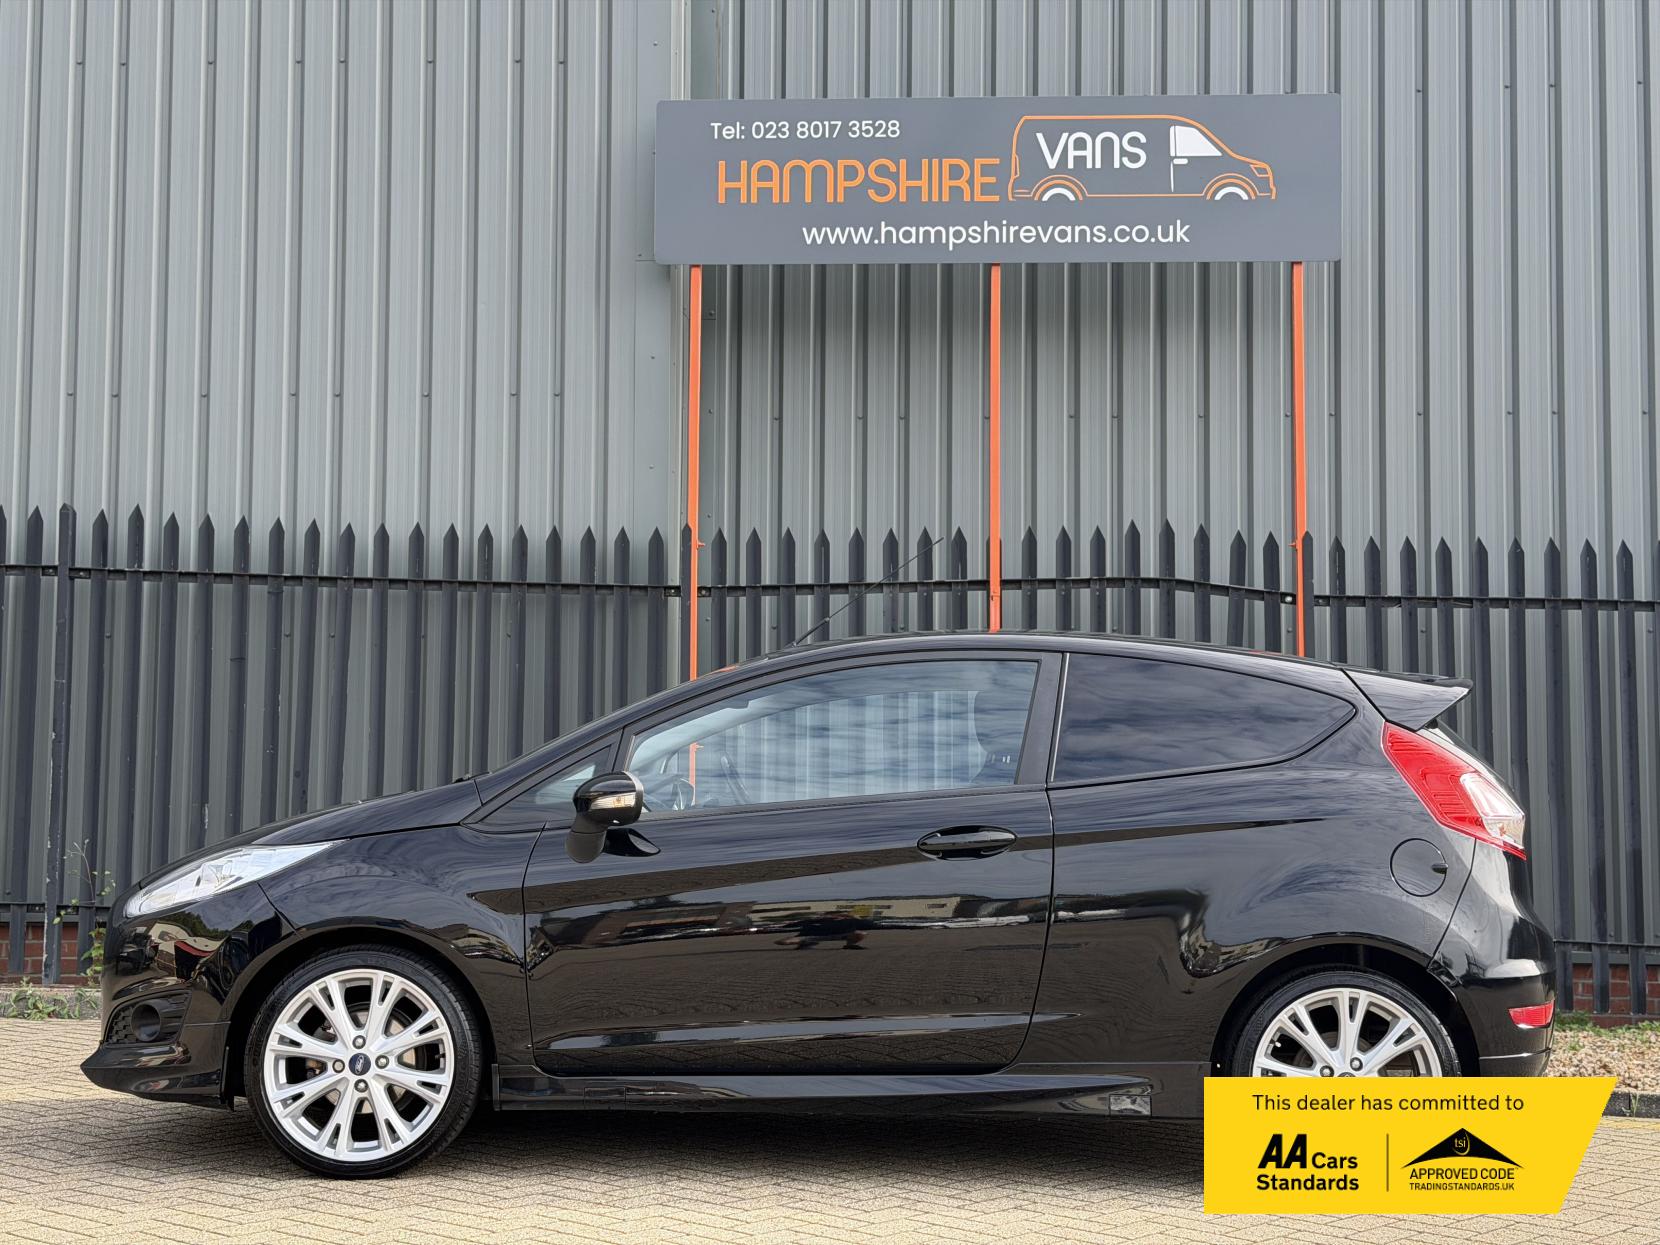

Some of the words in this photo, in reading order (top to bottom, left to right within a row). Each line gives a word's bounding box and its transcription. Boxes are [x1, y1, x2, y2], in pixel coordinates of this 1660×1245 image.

[710, 121, 745, 140] Tel:
[751, 121, 790, 139] 023
[796, 120, 841, 139] 8017
[847, 120, 900, 138] 3528
[1036, 131, 1147, 169] VANS
[717, 158, 1001, 203] HAMPSHIRE
[802, 219, 1190, 251] www.hampshirevans.co.uk
